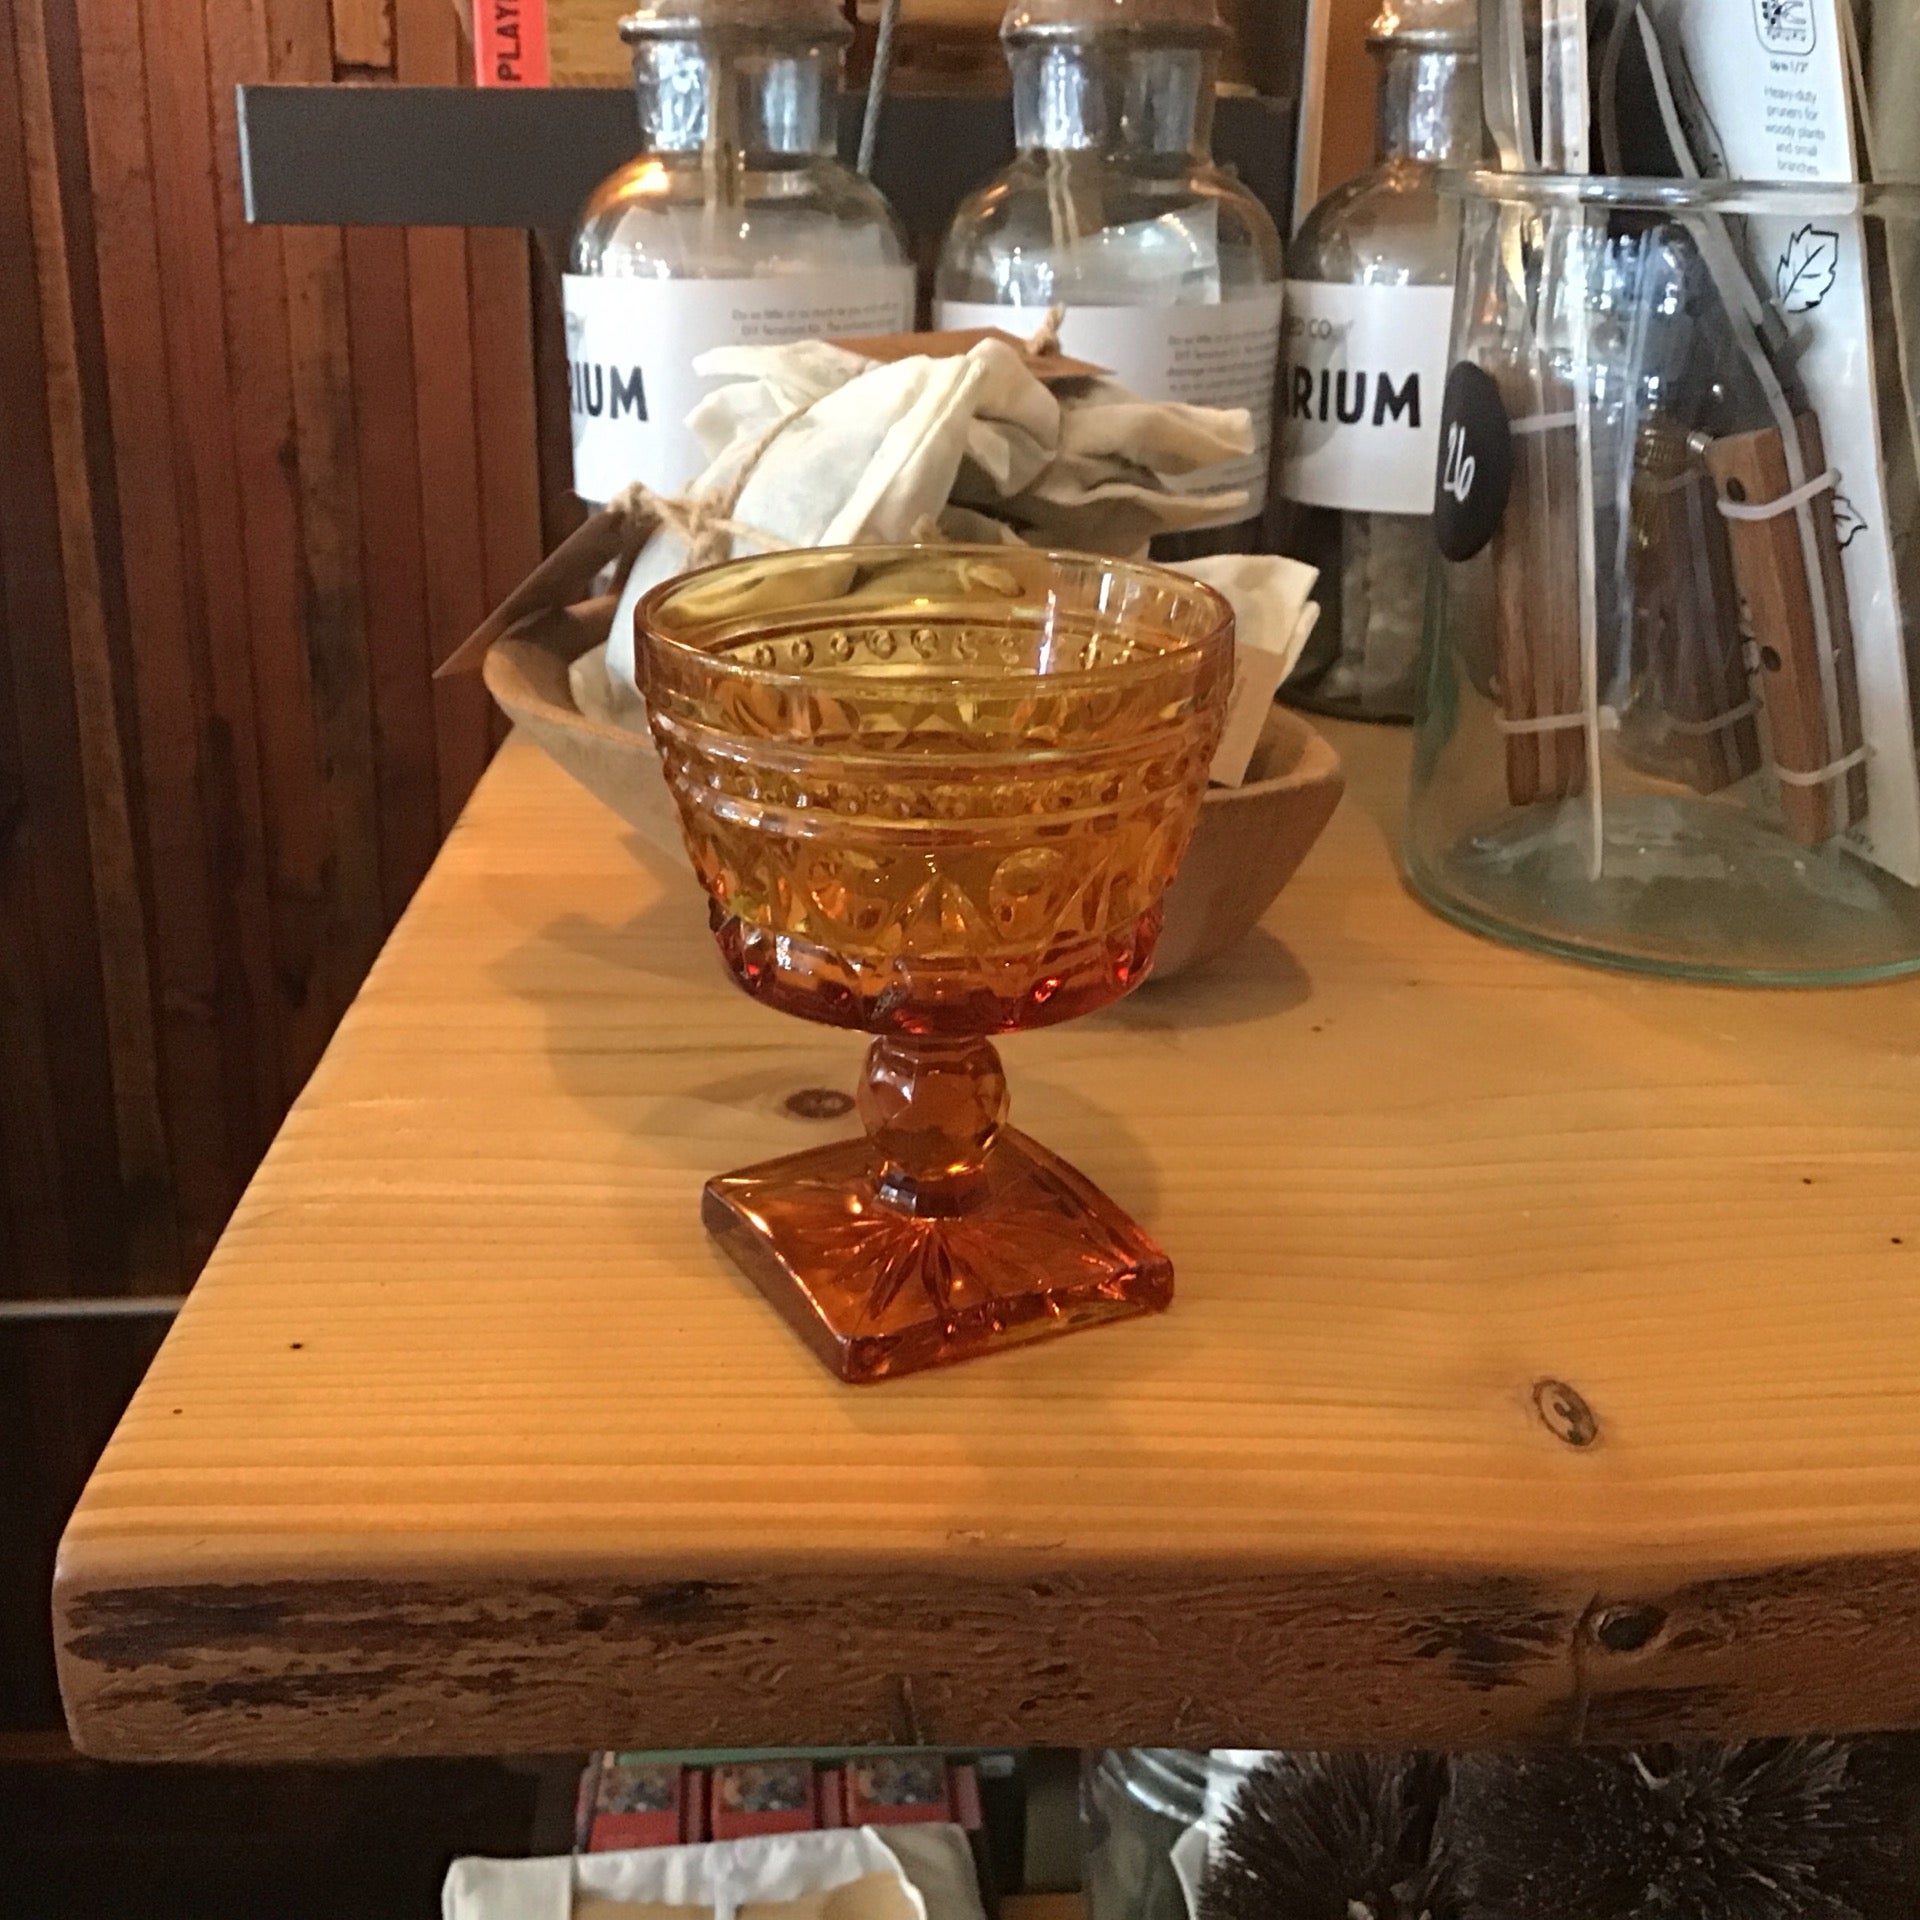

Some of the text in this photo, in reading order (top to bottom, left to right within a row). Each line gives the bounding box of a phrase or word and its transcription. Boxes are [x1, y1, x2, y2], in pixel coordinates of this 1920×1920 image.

[495, 0, 522, 82] PLAY
[573, 361, 649, 422] IUM
[1284, 365, 1421, 428] RIUM
